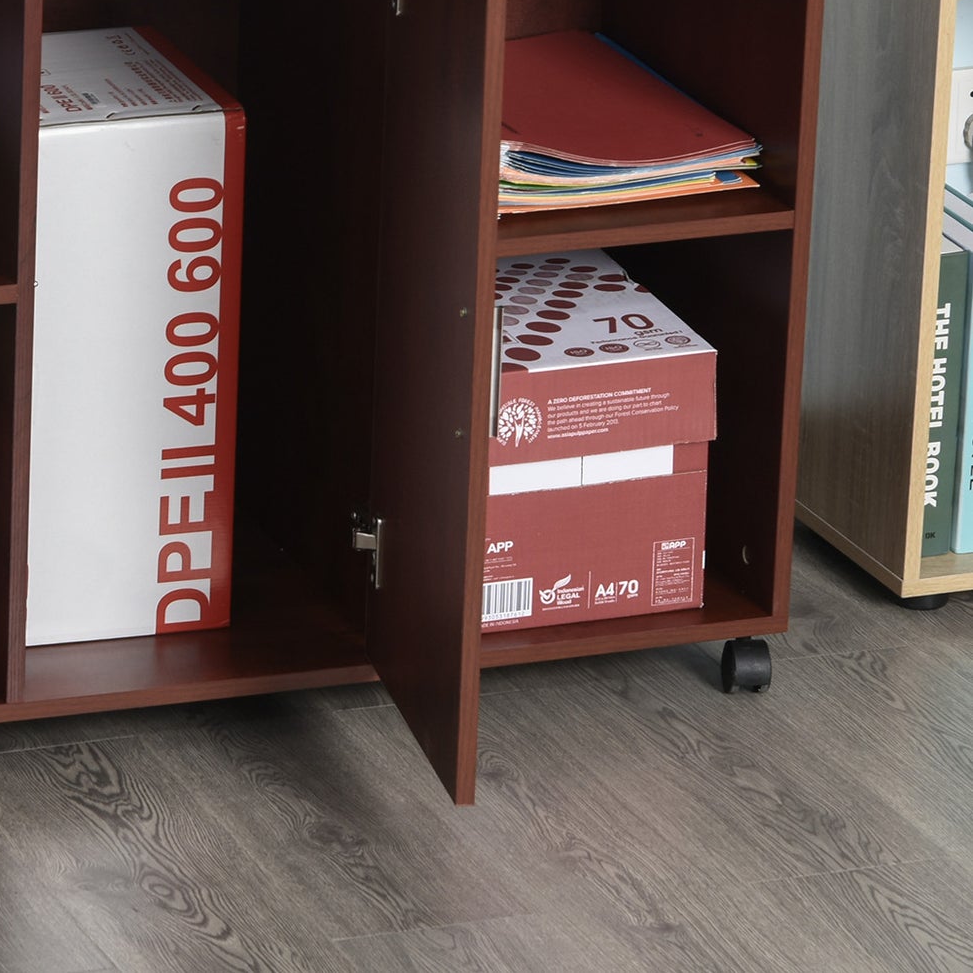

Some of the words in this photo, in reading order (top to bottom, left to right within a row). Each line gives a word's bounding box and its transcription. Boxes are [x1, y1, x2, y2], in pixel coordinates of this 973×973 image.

[167, 176, 224, 293] 600
[592, 313, 654, 334] 70
[634, 328, 663, 336] gsm
[163, 310, 219, 427] 400
[568, 392, 613, 402] DEFORESTATION
[614, 387, 652, 396] COMMITMENT
[487, 540, 514, 554] APP
[669, 540, 687, 549] APP
[556, 592, 581, 600] LEGAL
[594, 582, 615, 598] A4
[618, 579, 639, 596] 70
